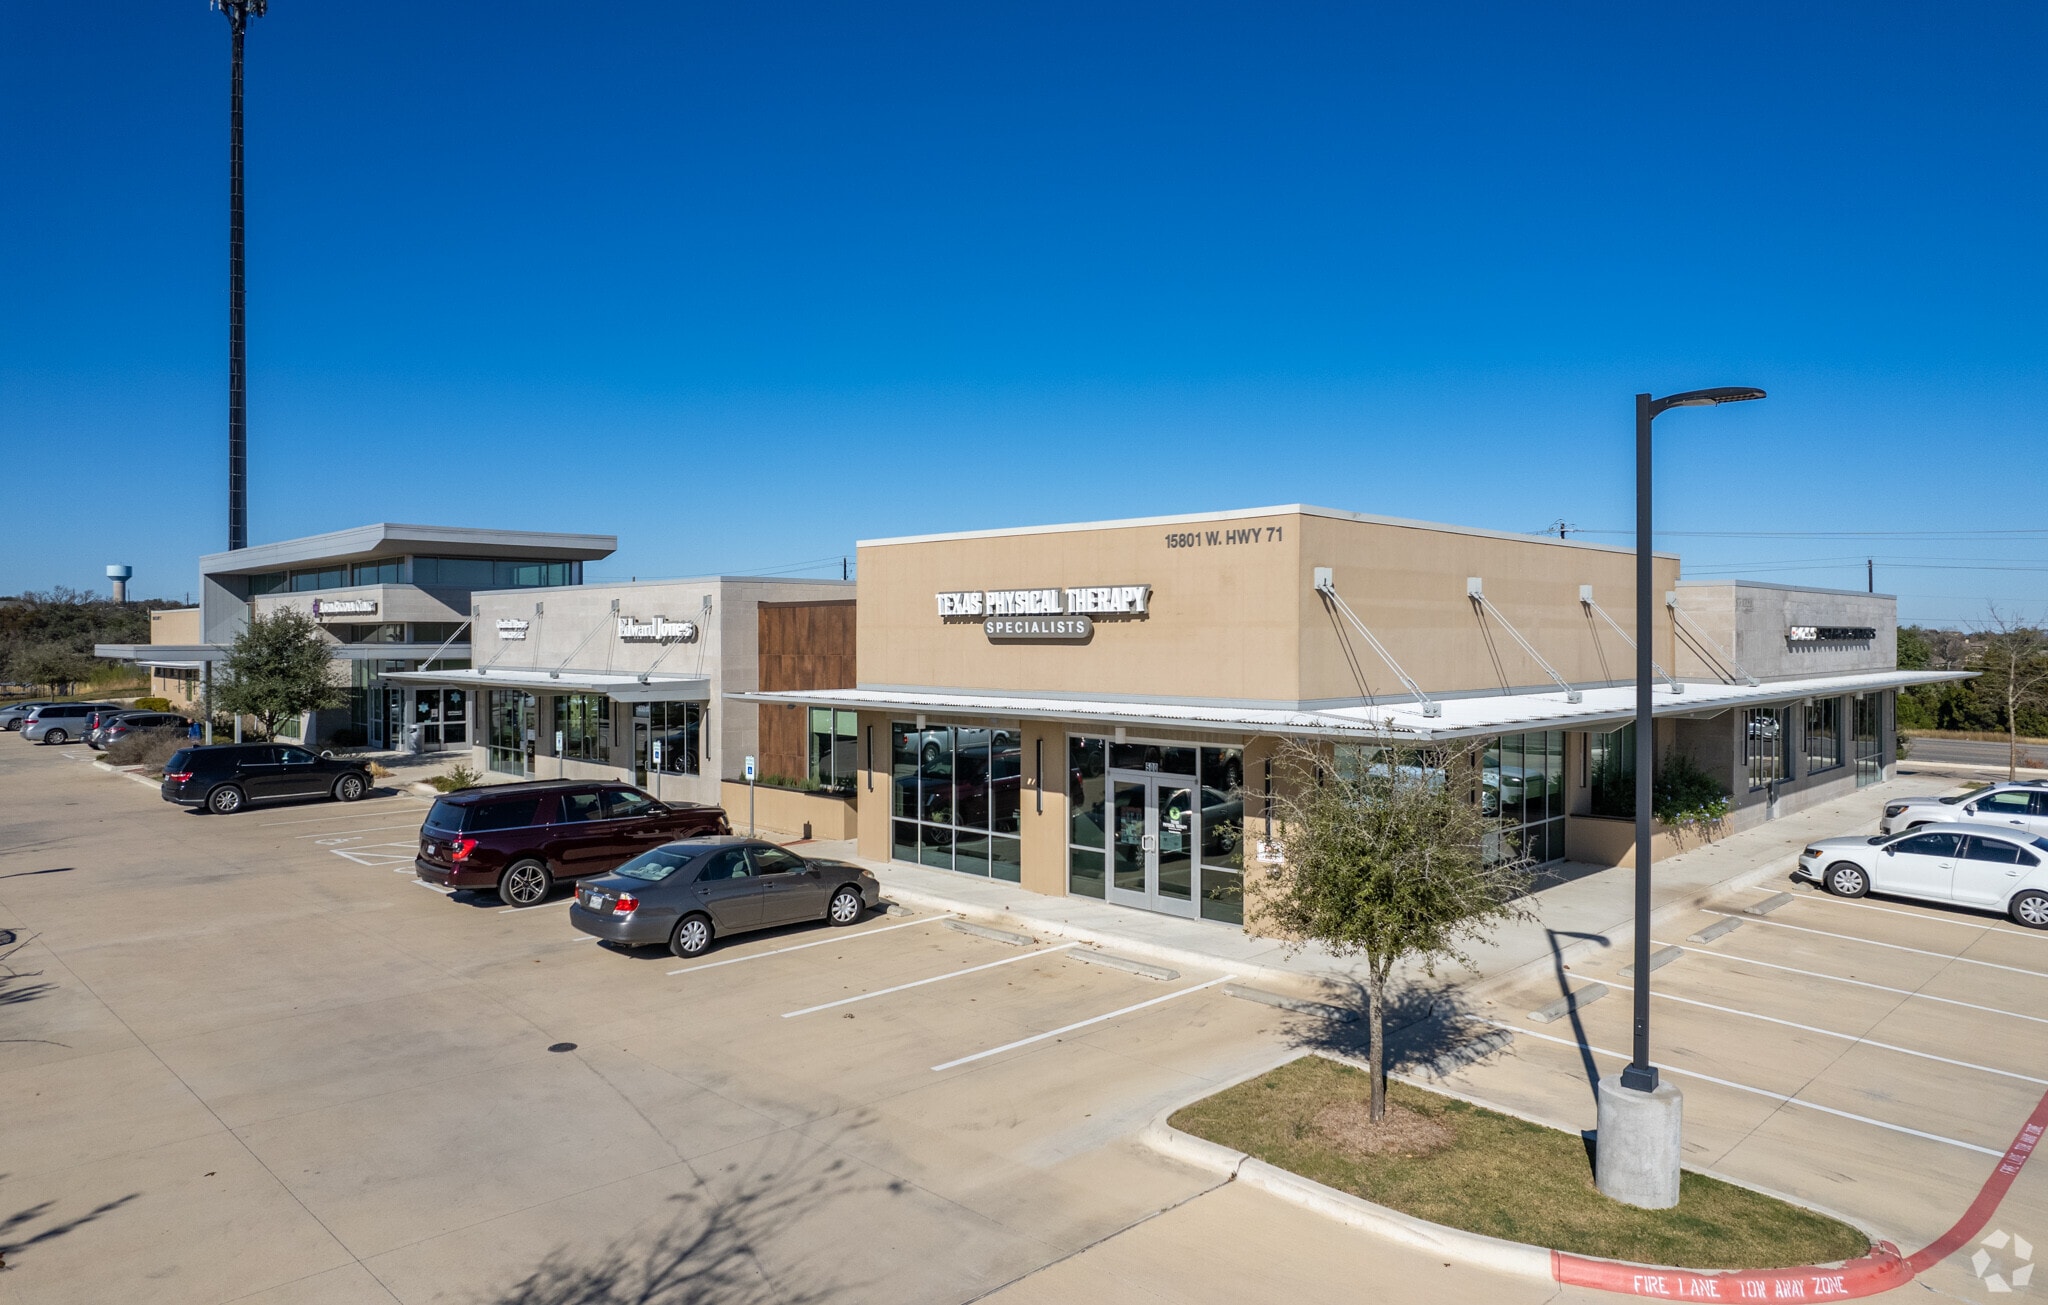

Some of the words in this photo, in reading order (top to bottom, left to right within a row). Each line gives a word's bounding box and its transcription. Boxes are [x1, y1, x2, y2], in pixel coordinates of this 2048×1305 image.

[1165, 532, 1202, 549] 15801
[1205, 532, 1222, 547] W.
[1226, 528, 1261, 546] HWY
[1267, 527, 1283, 543] 71
[935, 591, 983, 616] TEXAS
[985, 588, 1063, 615] PHYSICAL
[1065, 585, 1147, 614] THERAPY
[618, 617, 655, 637] Edward
[655, 617, 693, 639] Jones
[986, 620, 1085, 634] SPECIALISTS
[1633, 1275, 1670, 1295] FIRE
[1679, 1278, 1720, 1298] LANE
[1739, 1279, 1766, 1299] TOW
[1775, 1279, 1805, 1299] AWAY
[1813, 1275, 1849, 1295] ZONE
